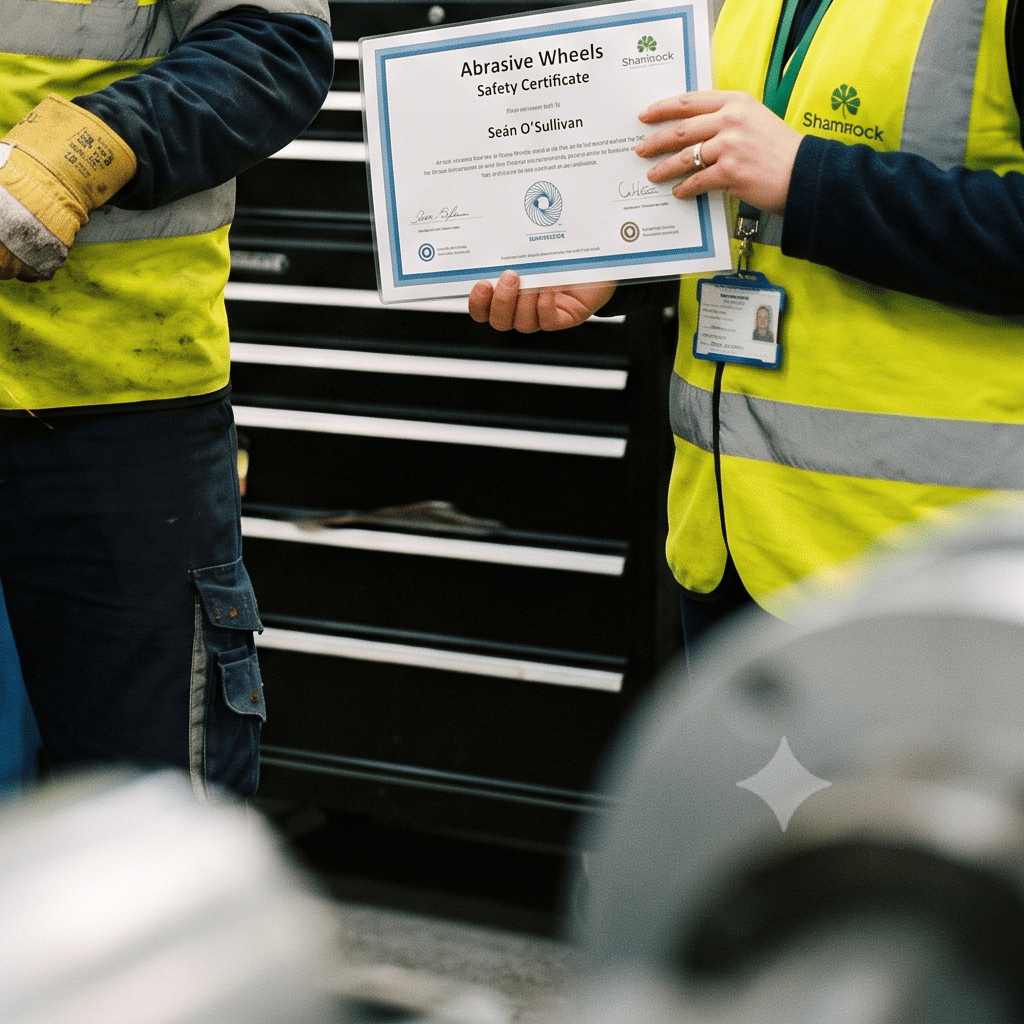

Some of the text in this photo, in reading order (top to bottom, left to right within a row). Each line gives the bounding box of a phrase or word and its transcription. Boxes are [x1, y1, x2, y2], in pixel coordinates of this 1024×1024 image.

[460, 44, 604, 78] Abrasive Wheels
[477, 72, 590, 97] Safety Certificate
[487, 116, 584, 139] Seán O'Sullivan
